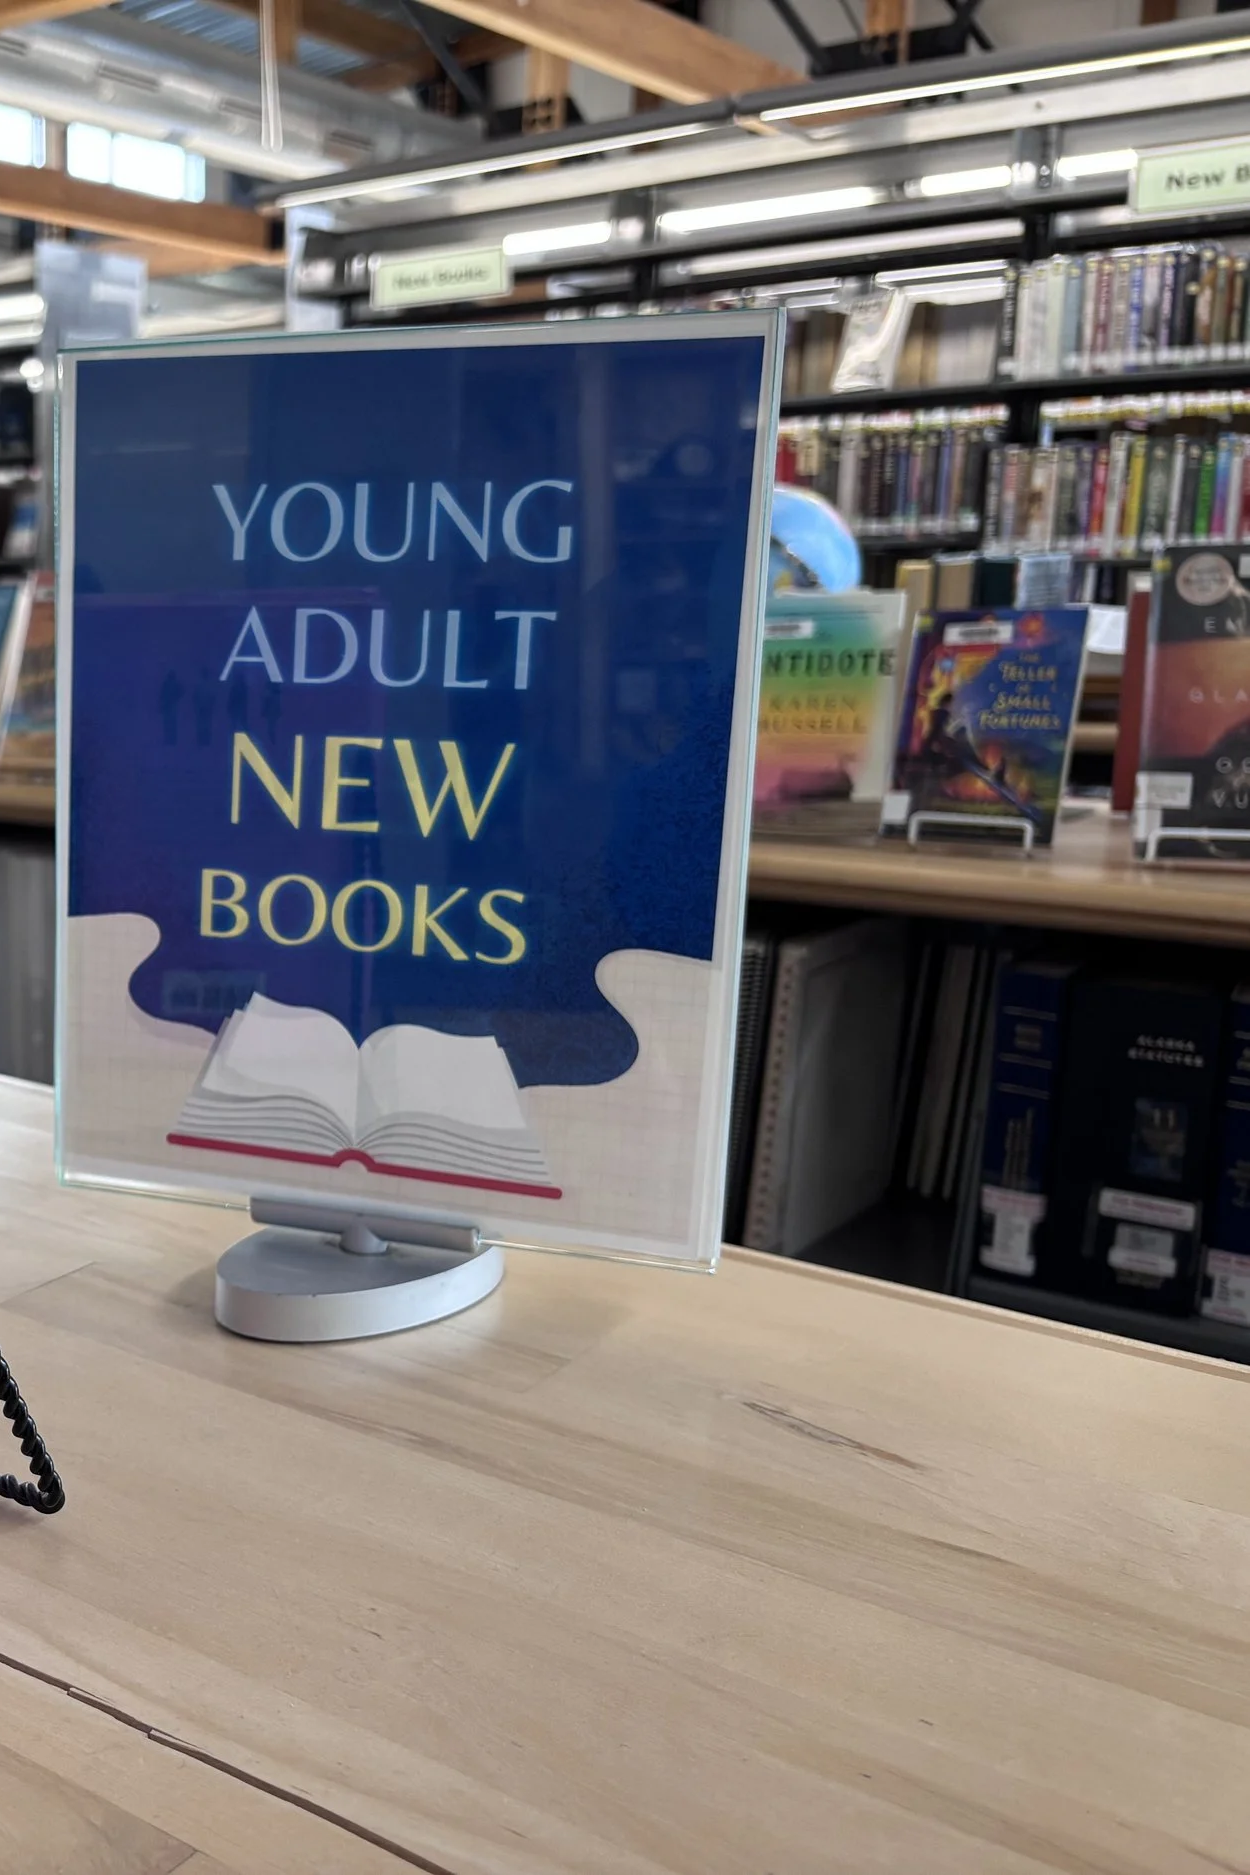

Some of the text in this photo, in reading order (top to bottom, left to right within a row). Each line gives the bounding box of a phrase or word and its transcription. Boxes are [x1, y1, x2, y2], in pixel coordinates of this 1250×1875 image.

[1165, 168, 1225, 192] New
[211, 479, 575, 564] YOUNG
[219, 605, 558, 690] ADULT
[230, 731, 516, 841] NEW
[199, 867, 527, 965] BOOKS
